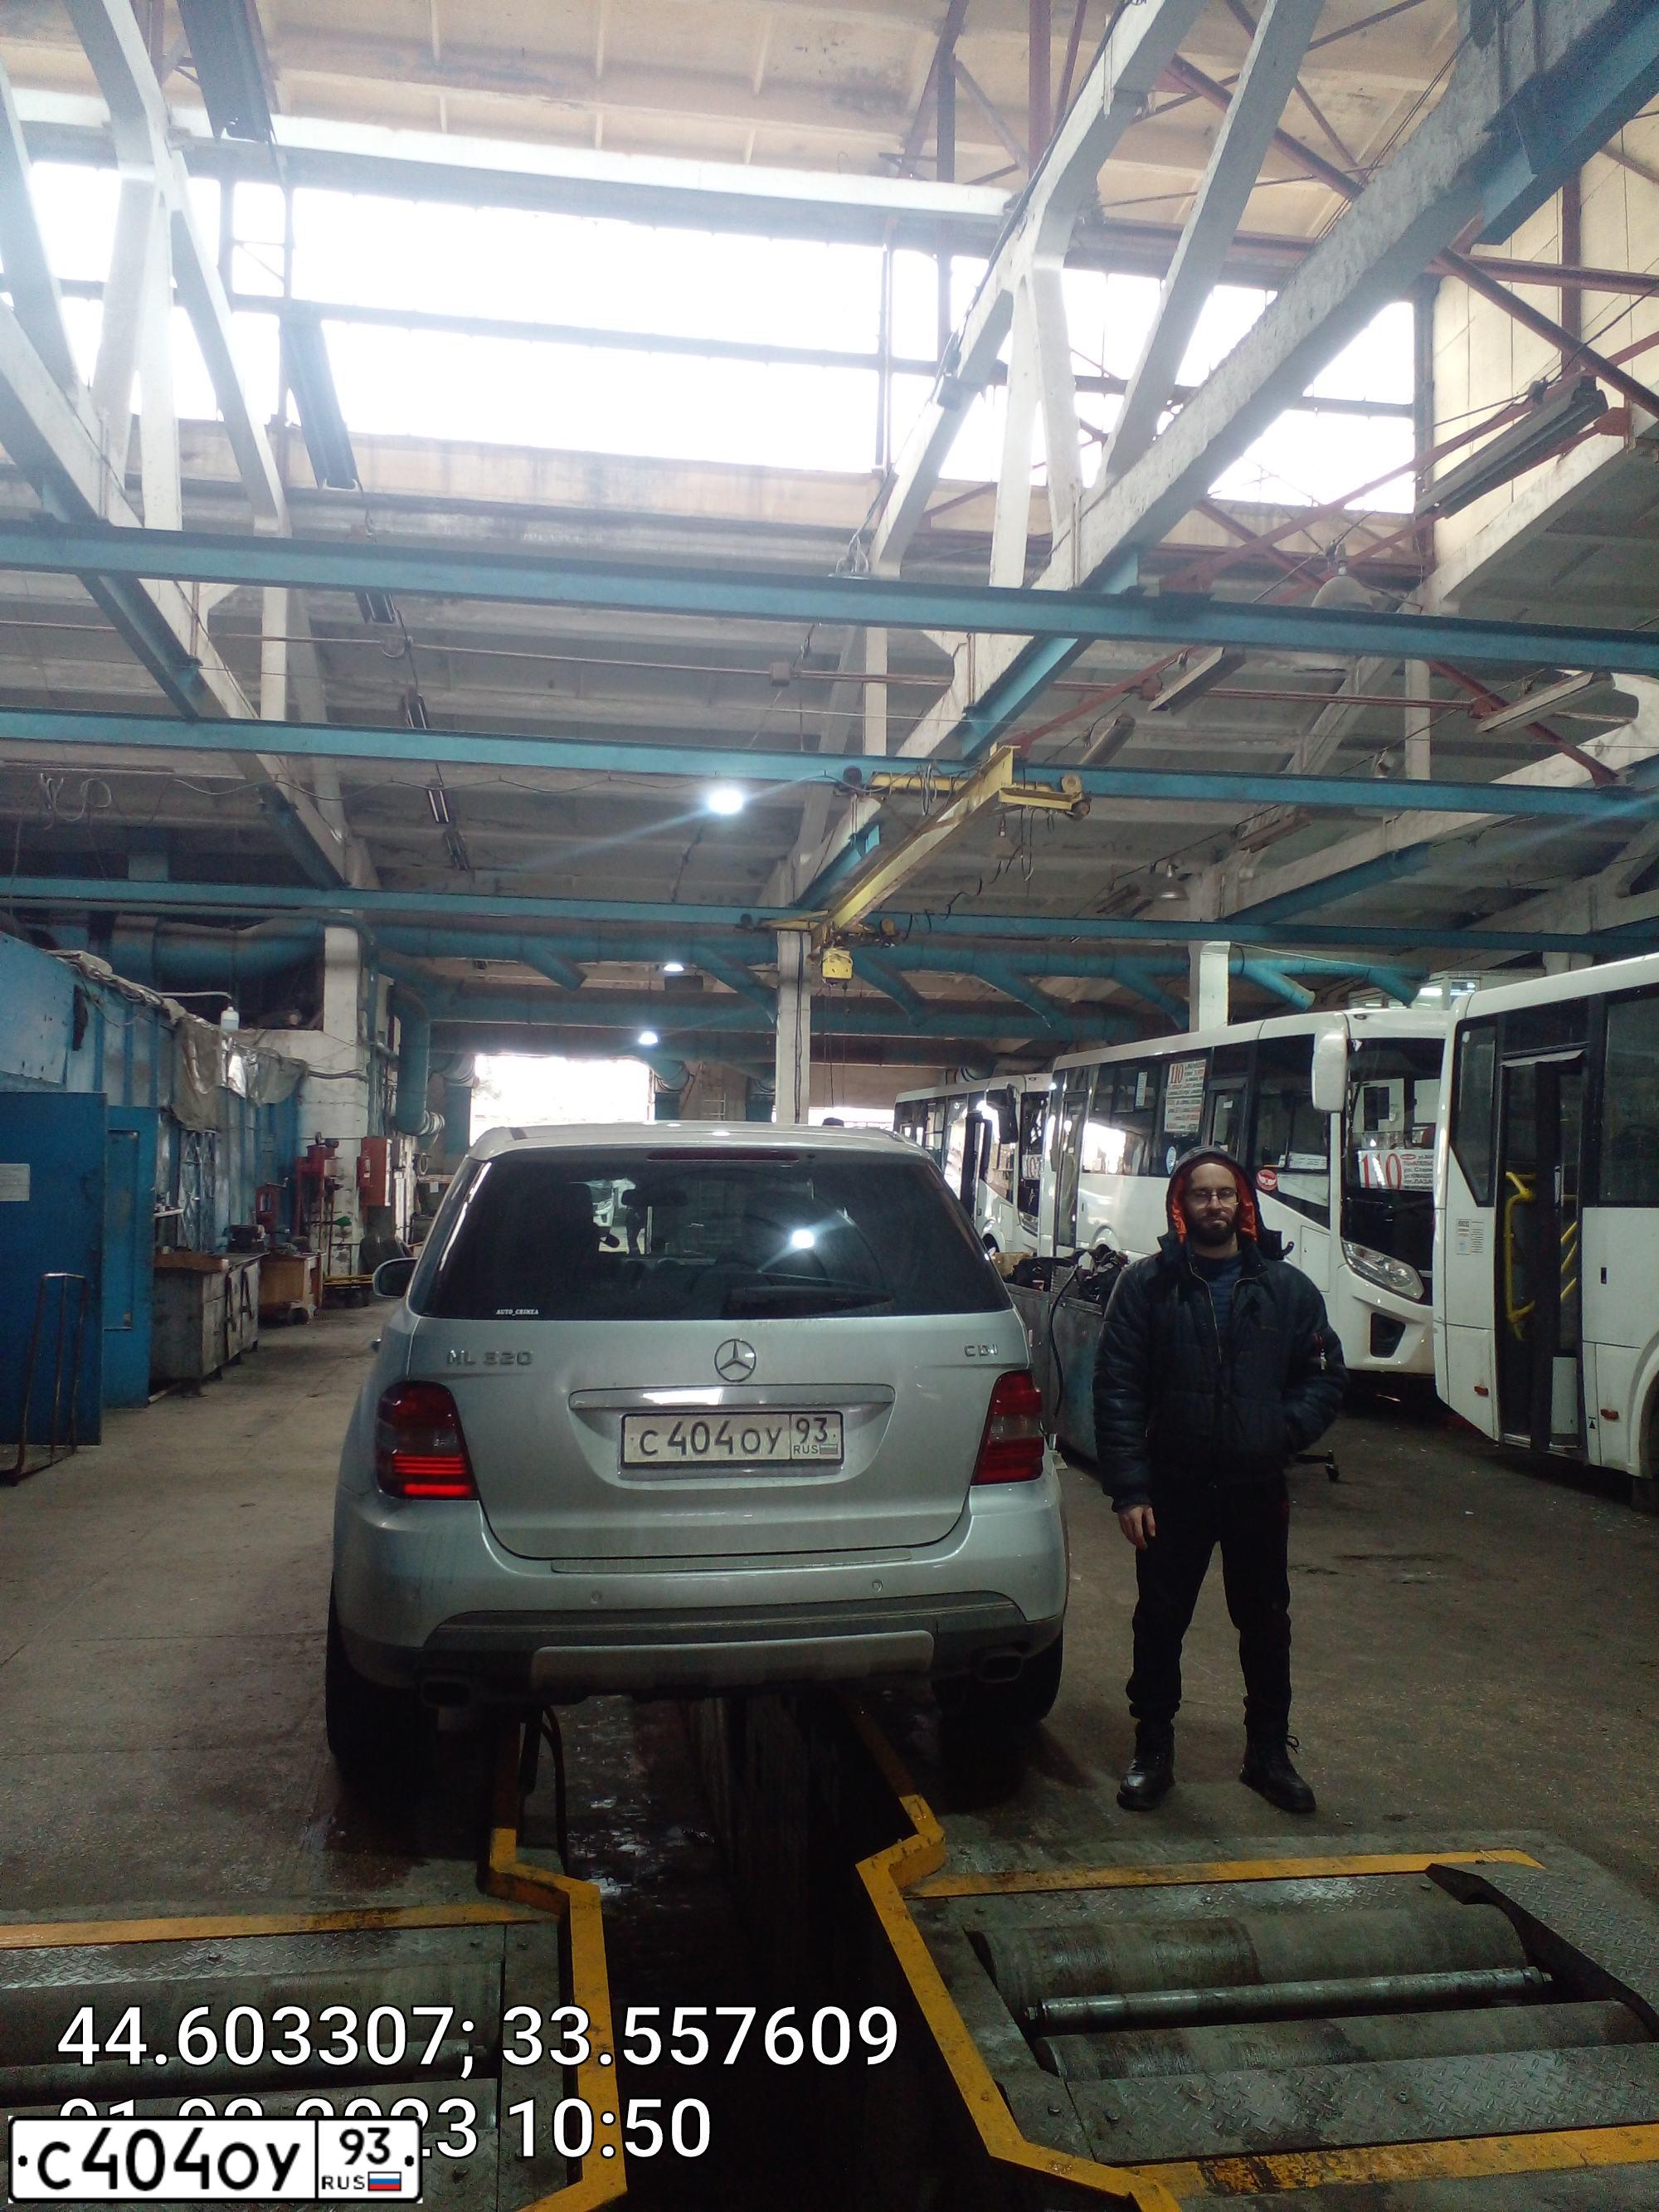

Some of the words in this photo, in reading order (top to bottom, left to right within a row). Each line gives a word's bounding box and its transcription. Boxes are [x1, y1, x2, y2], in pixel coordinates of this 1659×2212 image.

[448, 1349, 477, 1366] ML
[964, 1343, 999, 1357] CDI
[795, 1416, 828, 1445] 93
[793, 1444, 819, 1454] RUS
